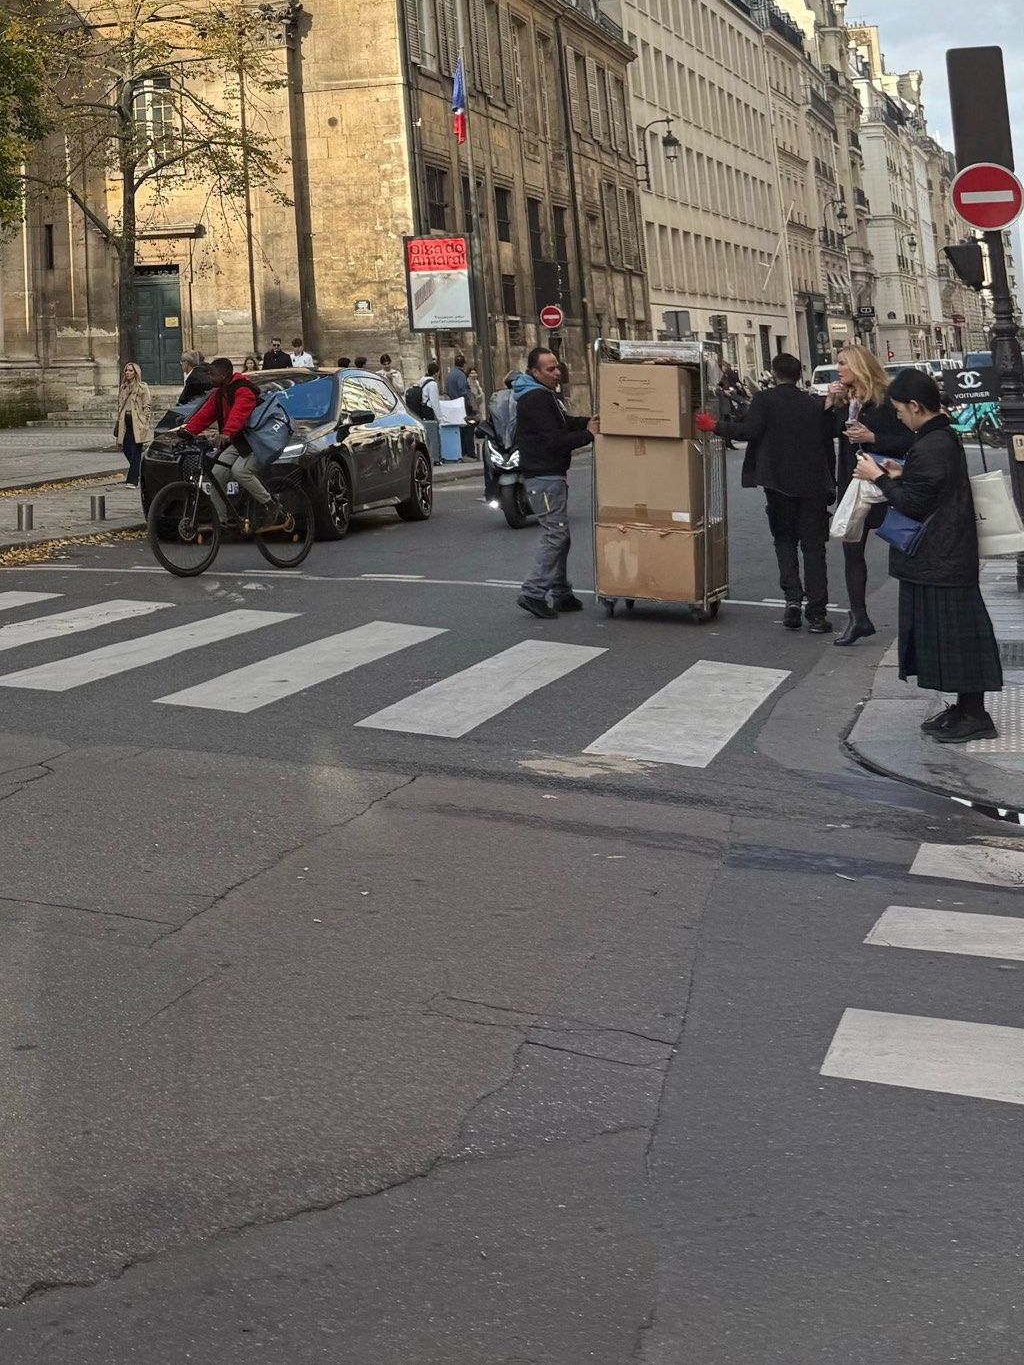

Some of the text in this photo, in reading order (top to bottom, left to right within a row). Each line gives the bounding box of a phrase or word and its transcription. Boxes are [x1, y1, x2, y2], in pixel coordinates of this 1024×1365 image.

[410, 245, 443, 255] Olga
[411, 253, 465, 266] Amaral
[954, 391, 991, 400] VOITURIER
